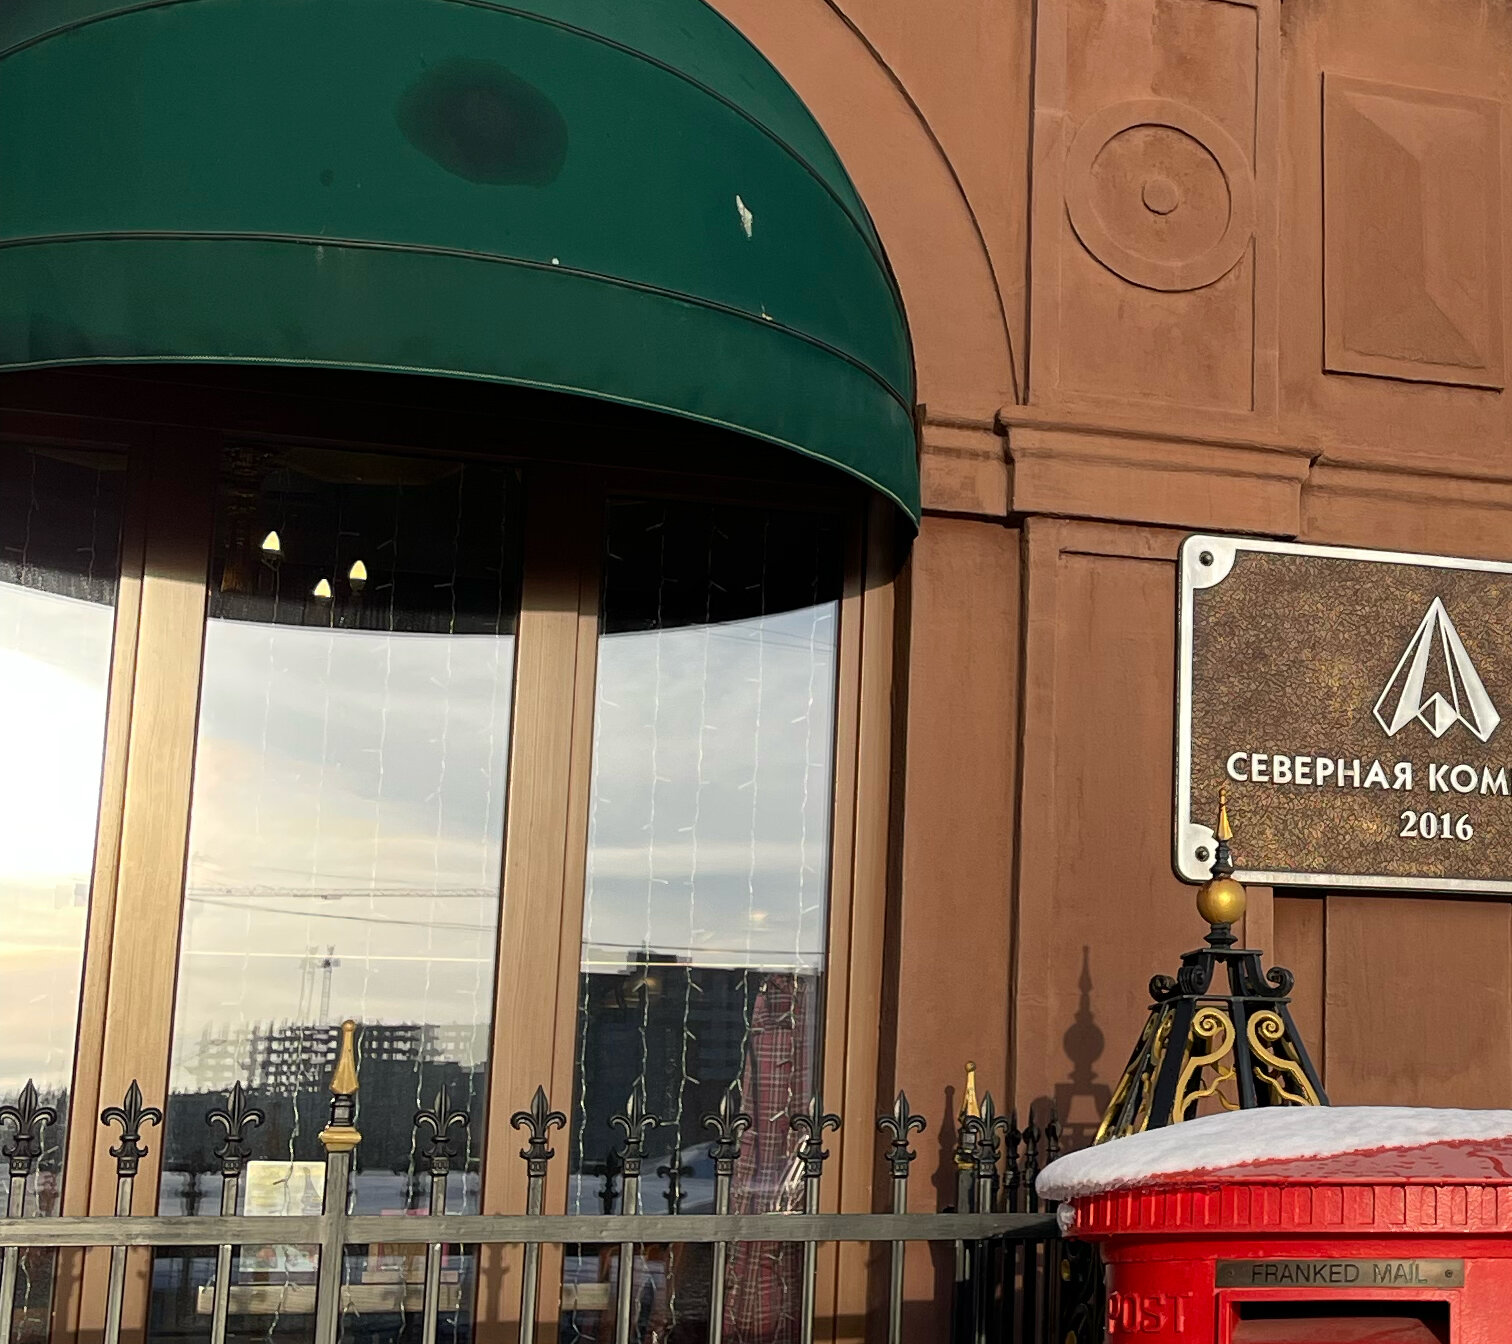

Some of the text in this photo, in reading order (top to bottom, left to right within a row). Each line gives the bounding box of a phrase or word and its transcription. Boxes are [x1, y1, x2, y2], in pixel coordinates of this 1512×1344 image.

[1226, 751, 1414, 791] СЕВЕРНАЯ
[1400, 810, 1474, 842] 2016
[1251, 1263, 1428, 1284] FRANKED MAIL
[1108, 1291, 1193, 1334] POST
